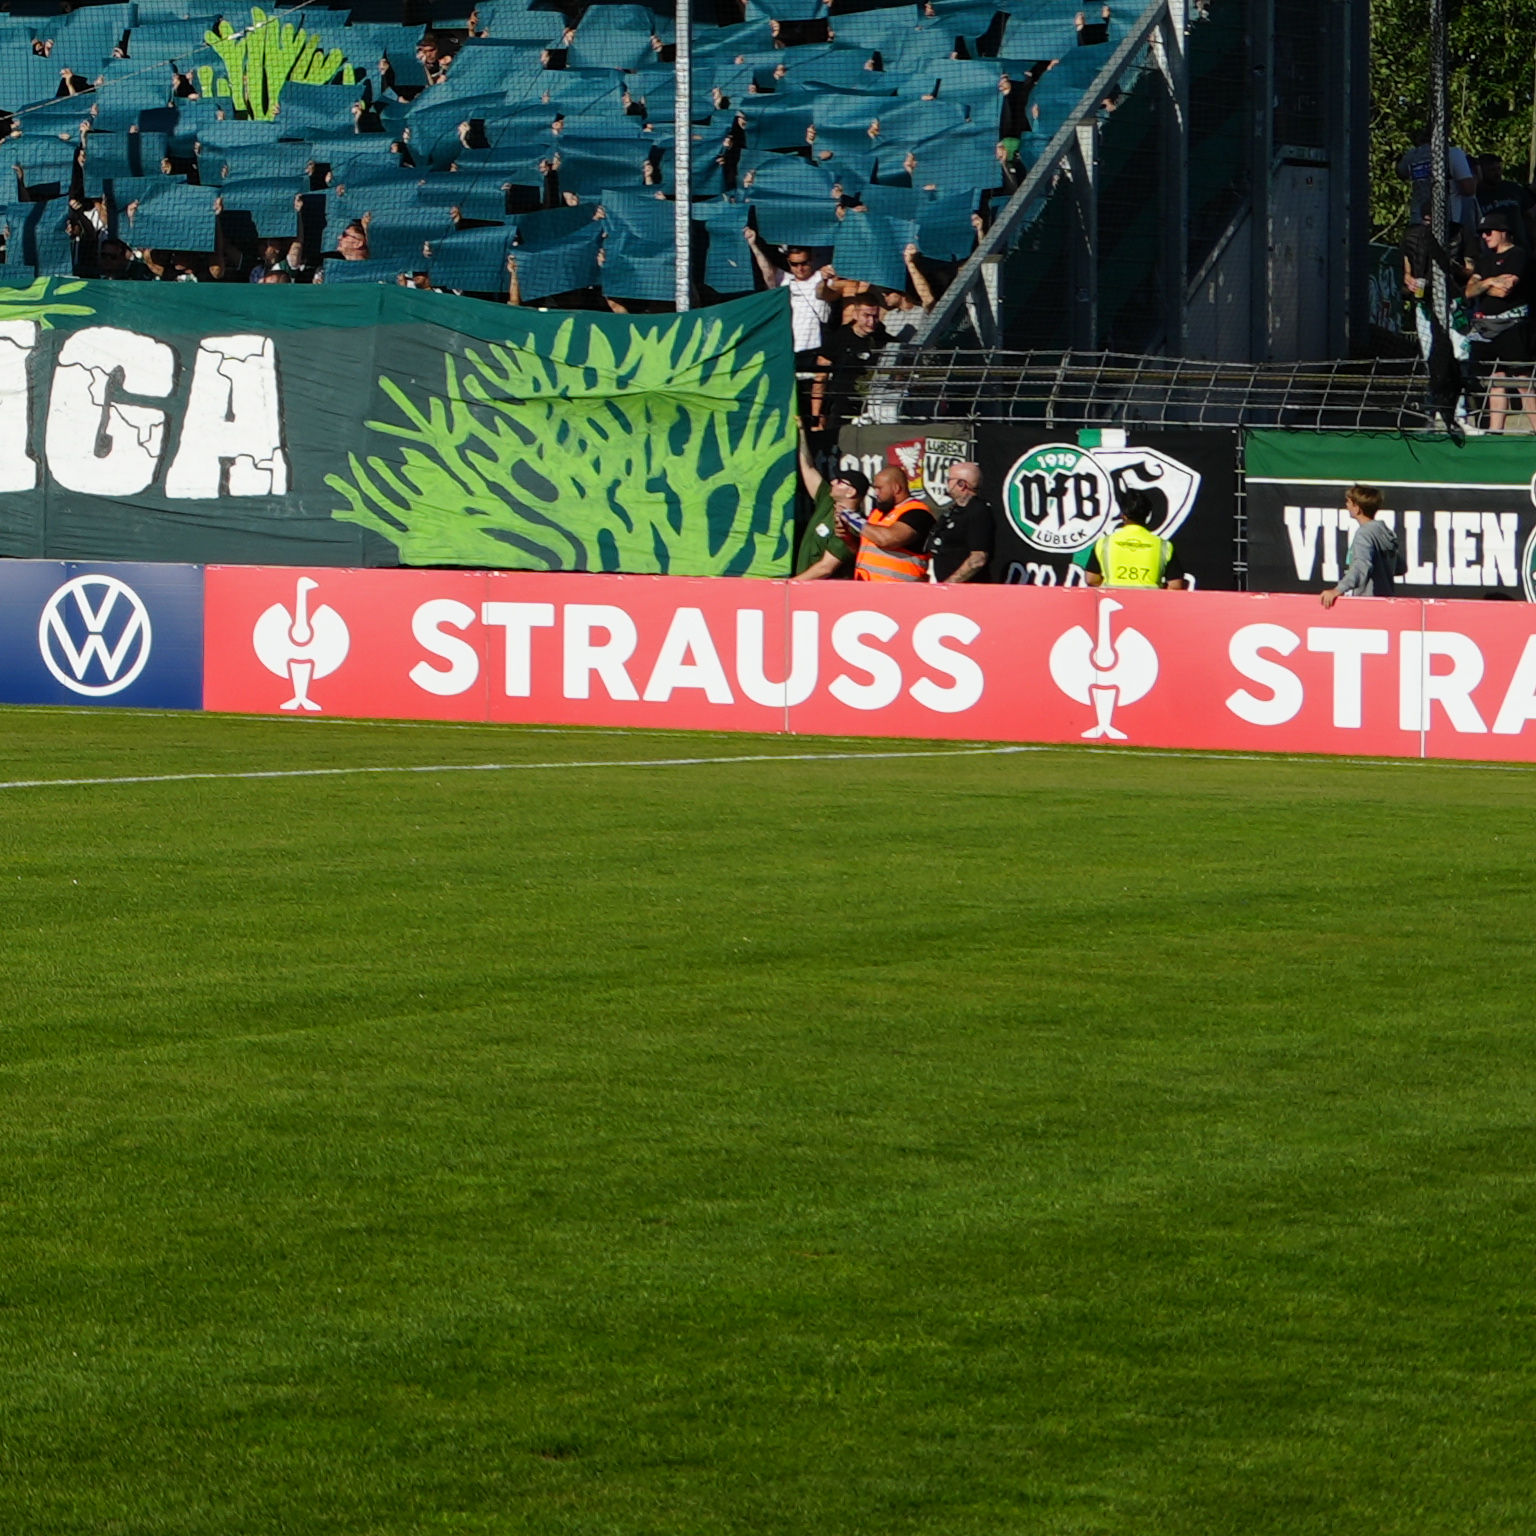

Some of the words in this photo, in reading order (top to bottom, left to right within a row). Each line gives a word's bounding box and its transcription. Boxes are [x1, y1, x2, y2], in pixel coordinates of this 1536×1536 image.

[1036, 453, 1077, 469] 1919
[1035, 528, 1088, 545] LÜBECK
[1284, 505, 1519, 587] VITLIEN
[1116, 565, 1151, 582] 287
[408, 598, 985, 713] STRAUSS
